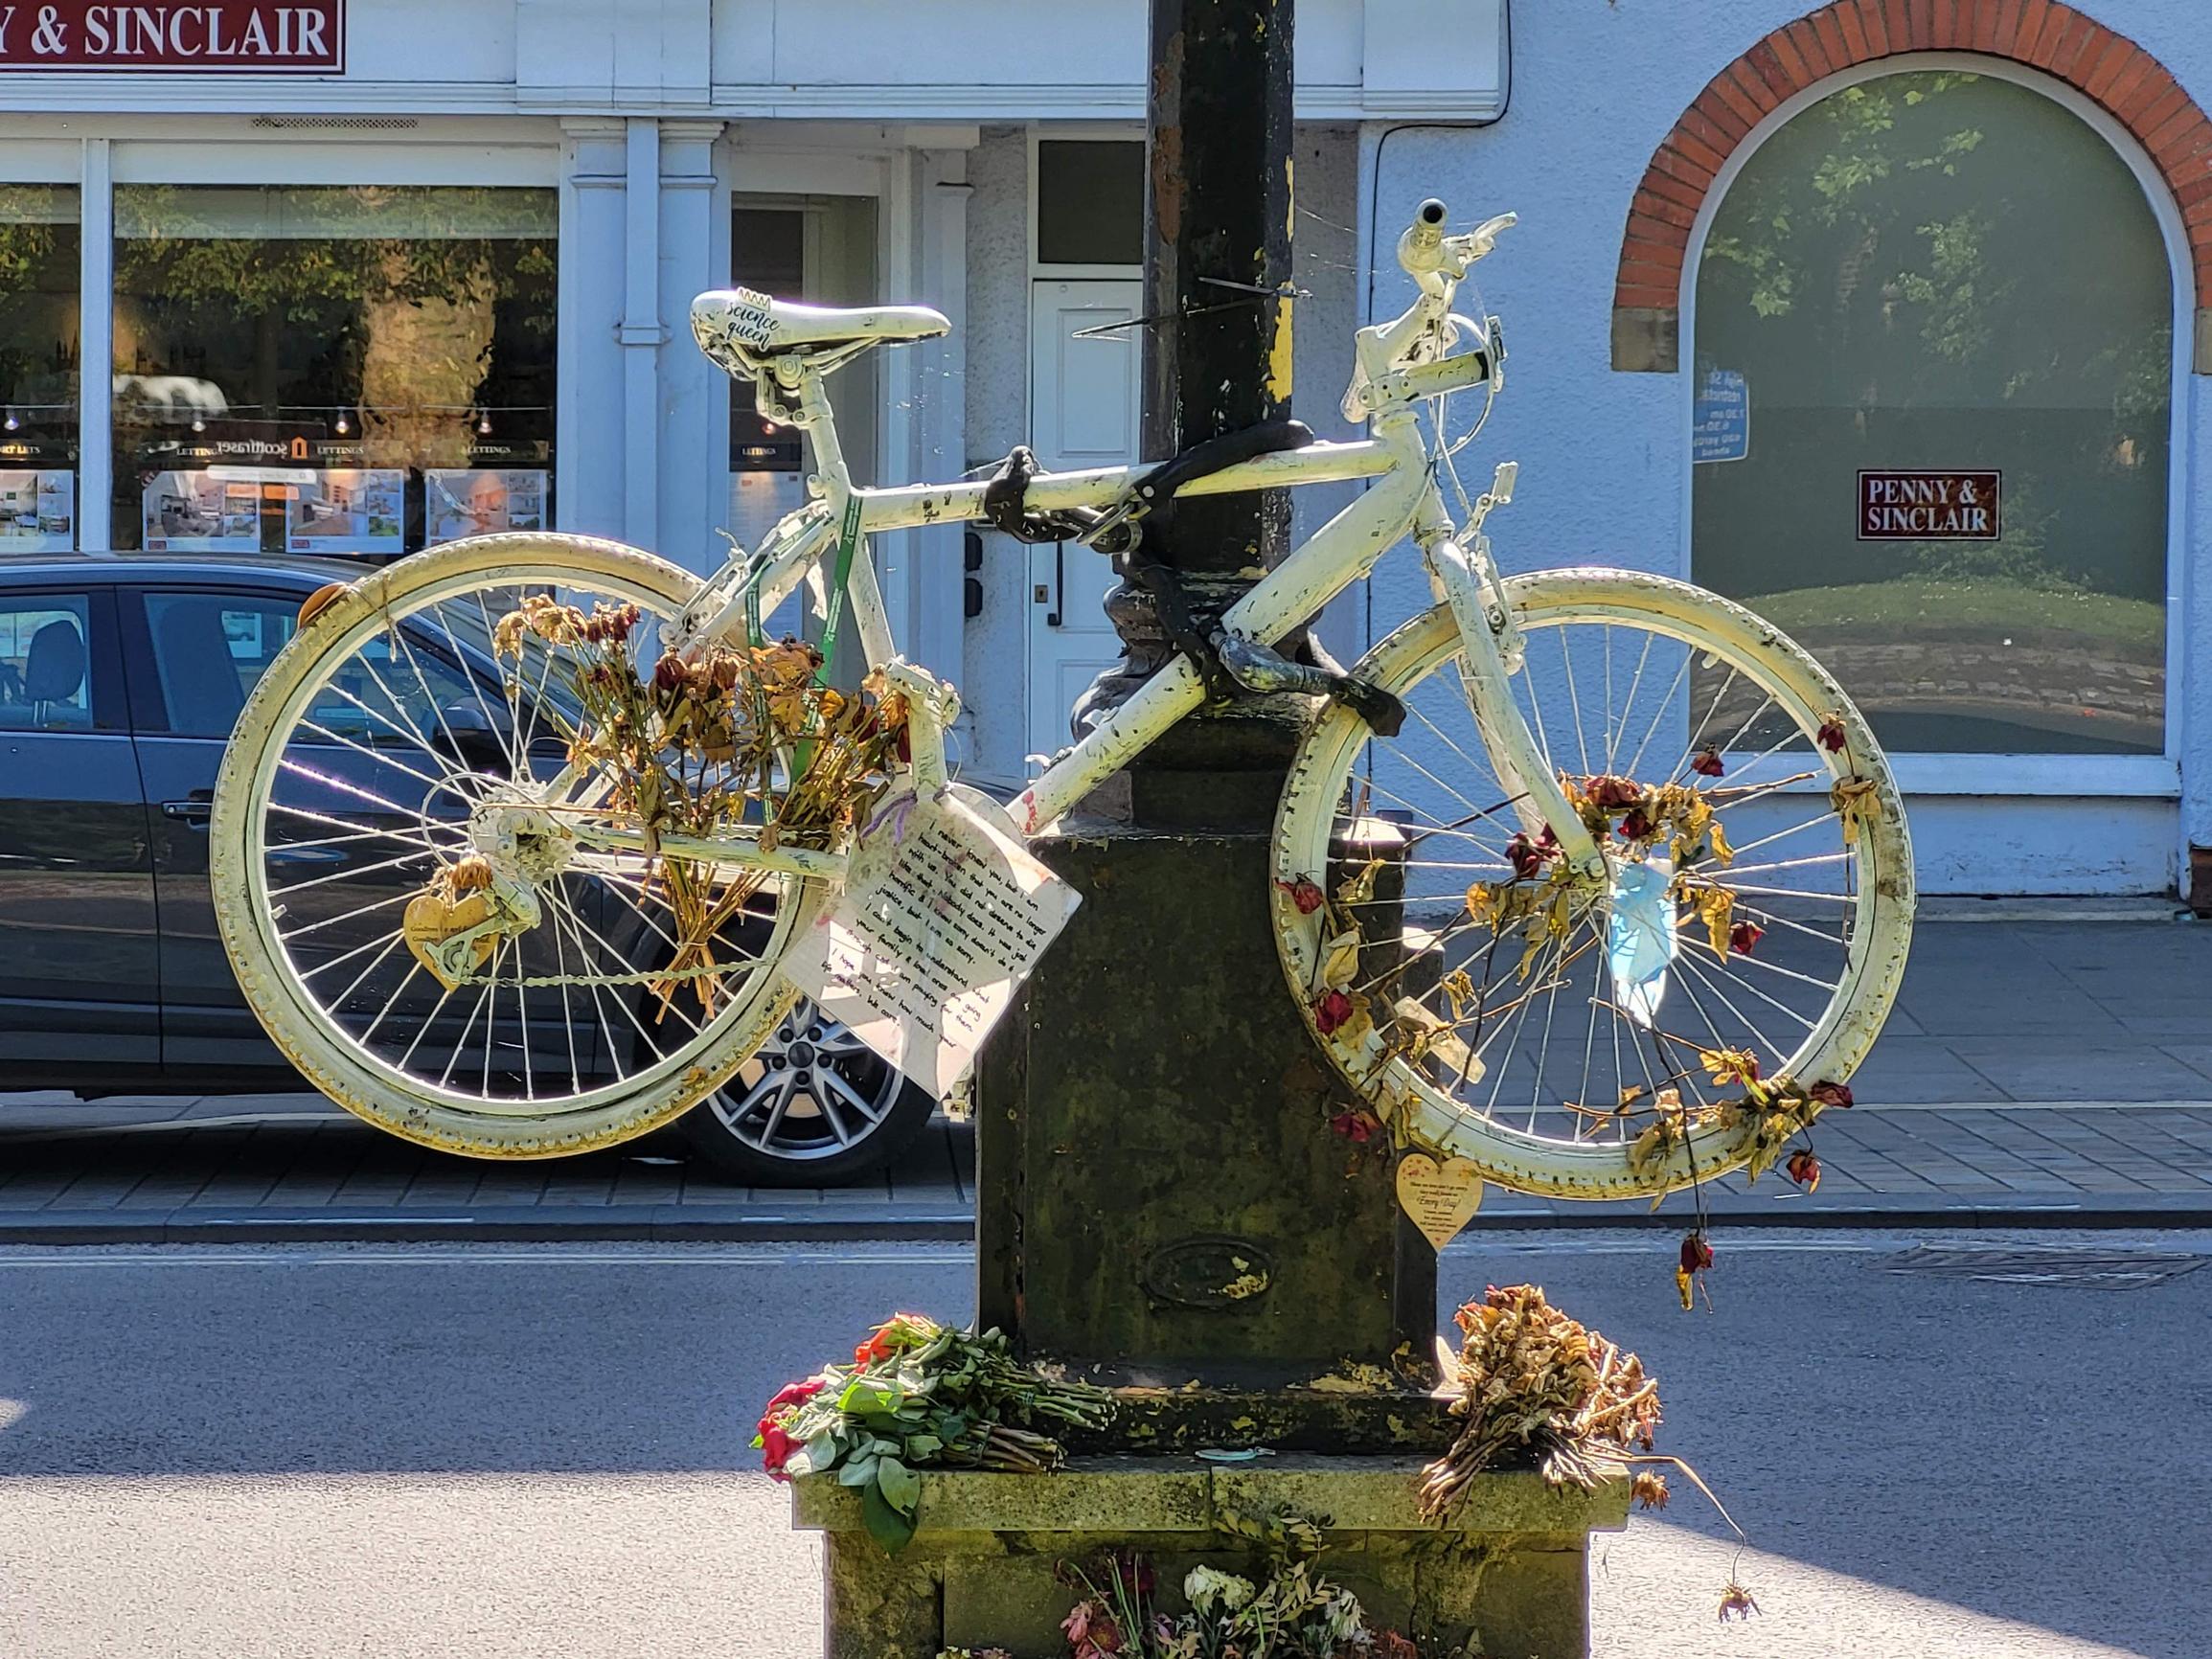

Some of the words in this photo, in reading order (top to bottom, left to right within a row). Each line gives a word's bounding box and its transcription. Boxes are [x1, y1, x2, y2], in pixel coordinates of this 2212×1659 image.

[31, 6, 68, 55] &
[84, 6, 330, 56] SINCLAIR
[726, 302, 781, 331] science
[727, 322, 770, 351] queen
[317, 445, 364, 455] LETTINGS
[467, 445, 512, 454] LETTINGS
[1867, 507, 1988, 532] SINCLAIR
[1868, 480, 1951, 504] PENNY
[1958, 478, 1977, 505] &
[907, 847, 926, 863] with
[926, 861, 939, 875] us.
[944, 869, 960, 889] You
[959, 886, 973, 900] did
[973, 899, 987, 910] not
[988, 909, 1014, 932] deserve
[1015, 929, 1024, 941] to
[1025, 938, 1037, 950] die
[937, 830, 963, 850] never
[989, 869, 1003, 885] you,
[1004, 878, 1018, 894] but
[1026, 898, 1038, 911] am
[875, 883, 904, 910] justice,
[905, 905, 923, 920] but
[929, 925, 942, 939] am
[945, 937, 953, 947] so
[955, 944, 976, 965] sorry.
[888, 869, 916, 897] horrific
[952, 922, 970, 941] sorry
[969, 936, 996, 958] doesn't
[997, 957, 1007, 967] do
[898, 857, 912, 875] like
[937, 889, 966, 918] Nobody
[966, 911, 985, 931] does.
[987, 926, 996, 937] It
[998, 938, 1012, 951] was
[1010, 947, 1028, 963] just
[969, 873, 984, 888] that
[984, 887, 998, 900] you
[1000, 898, 1014, 912] are
[1014, 909, 1023, 919] no
[1025, 915, 1047, 936] longer
[855, 918, 875, 933] your
[877, 933, 903, 959] family
[930, 977, 948, 991] ones
[962, 1004, 981, 1022] going
[893, 924, 913, 944] begin
[915, 942, 924, 954] to
[925, 952, 969, 989] understand
[839, 954, 855, 970] hope
[857, 972, 872, 985] you
[898, 998, 913, 1015] how
[914, 1015, 934, 1034] much
[938, 1034, 956, 1048] your
[866, 994, 878, 1010] We
[899, 971, 911, 984] am
[939, 1003, 952, 1013] for
